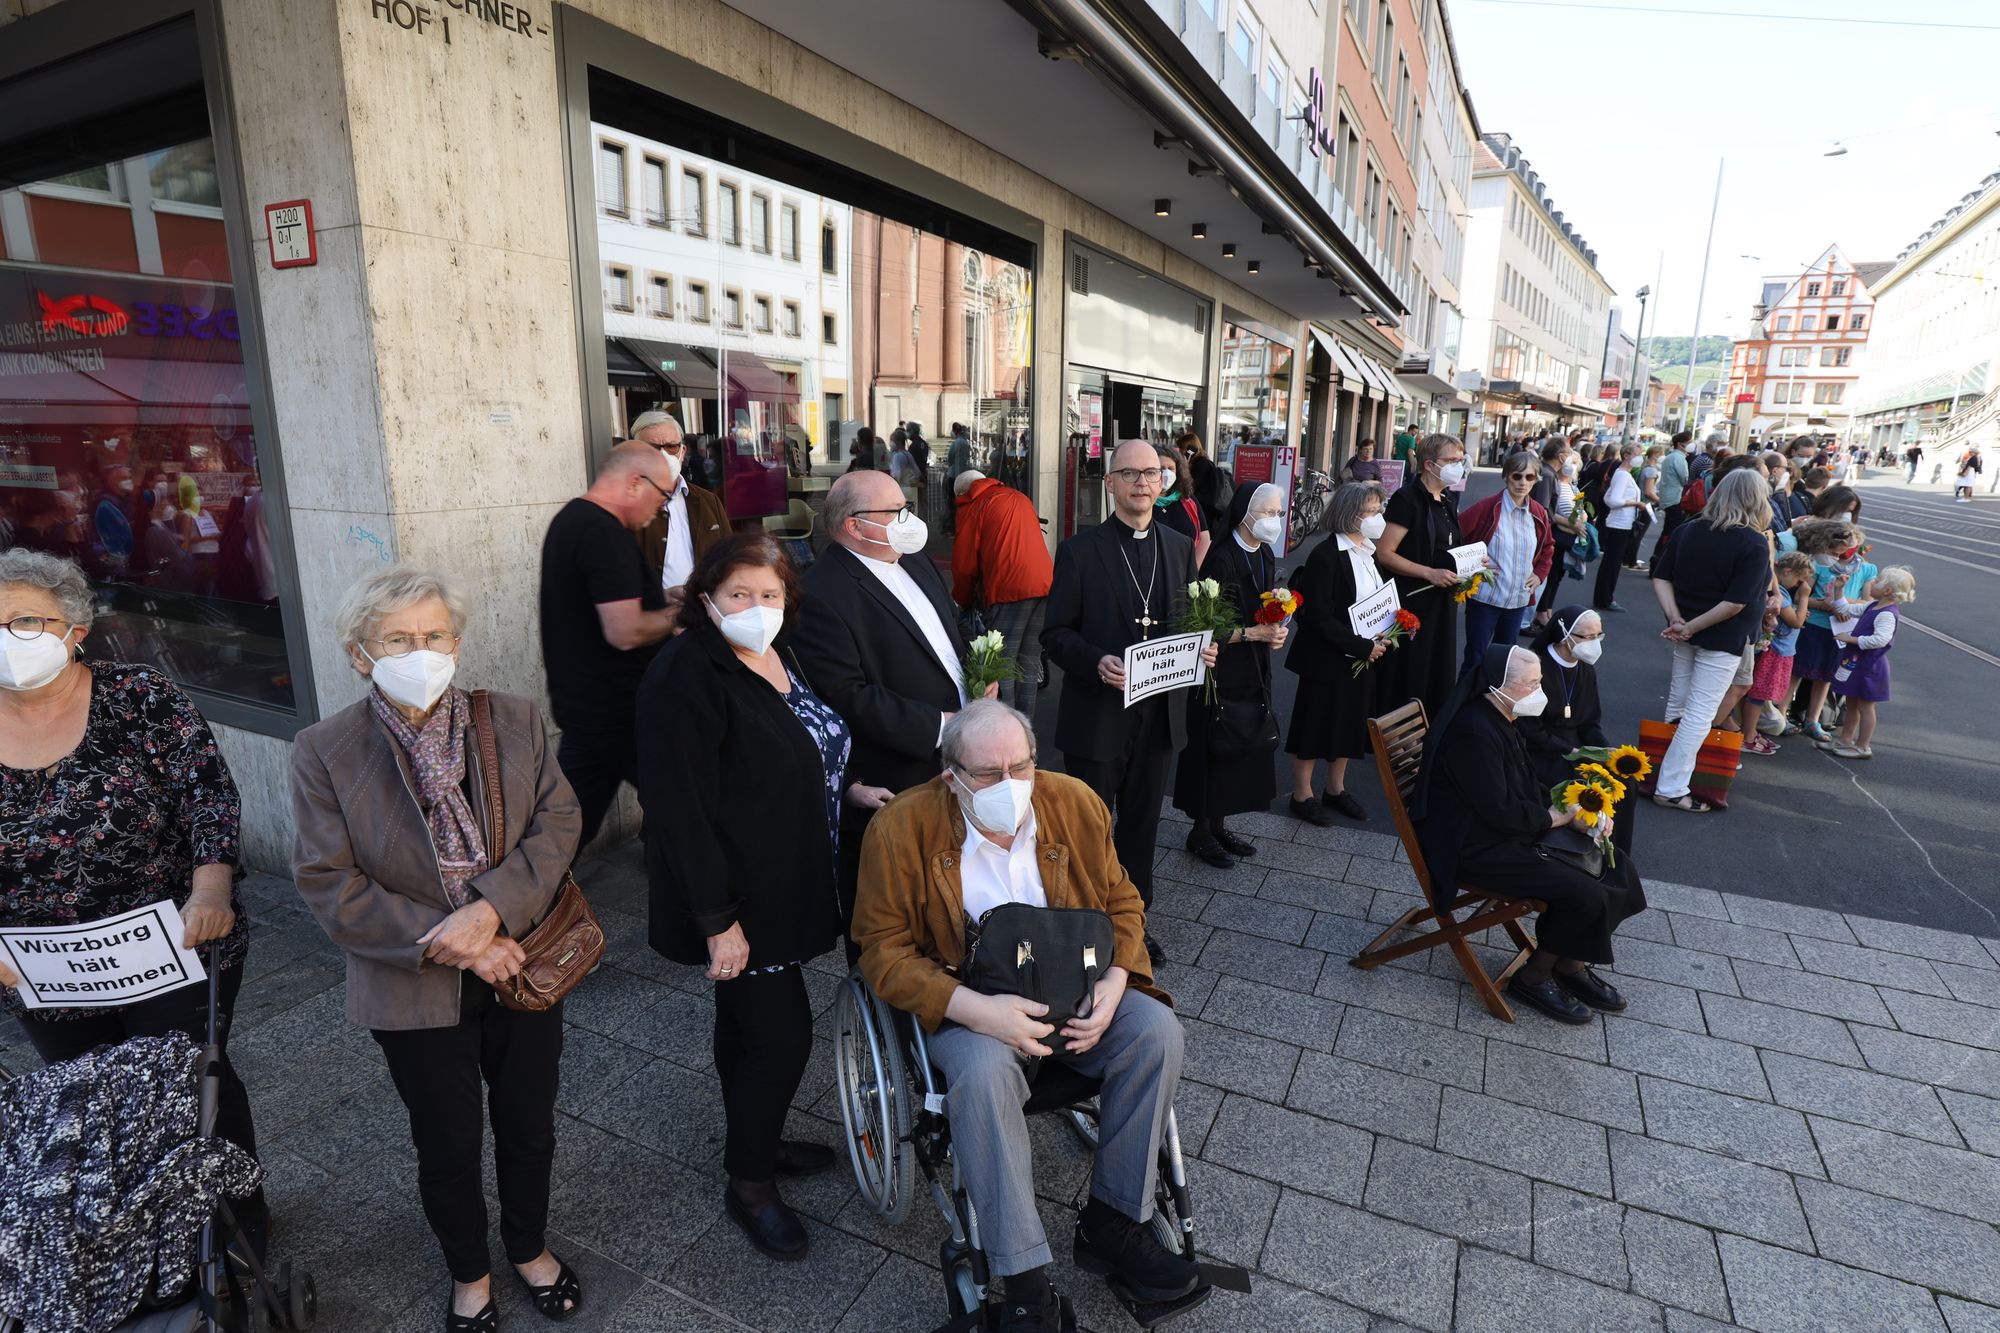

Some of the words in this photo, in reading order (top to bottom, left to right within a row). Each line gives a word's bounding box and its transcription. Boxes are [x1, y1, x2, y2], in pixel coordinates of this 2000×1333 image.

[372, 0, 431, 35] HOF
[442, 16, 451, 45] 1
[275, 208, 298, 225] H200
[5, 321, 36, 346] EINS:
[35, 314, 97, 343] FESTNETZ
[97, 311, 128, 338] UND
[23, 347, 105, 375] KOMBINIEREN
[1357, 596, 1393, 622] Würzburg
[1366, 608, 1391, 628] trauert
[1135, 641, 1196, 662] Würzburg
[1152, 658, 1176, 672] hält
[1131, 668, 1194, 693] zusammen
[15, 924, 152, 954] Würzburg
[35, 962, 177, 993] zusammen
[67, 956, 120, 974] hält
